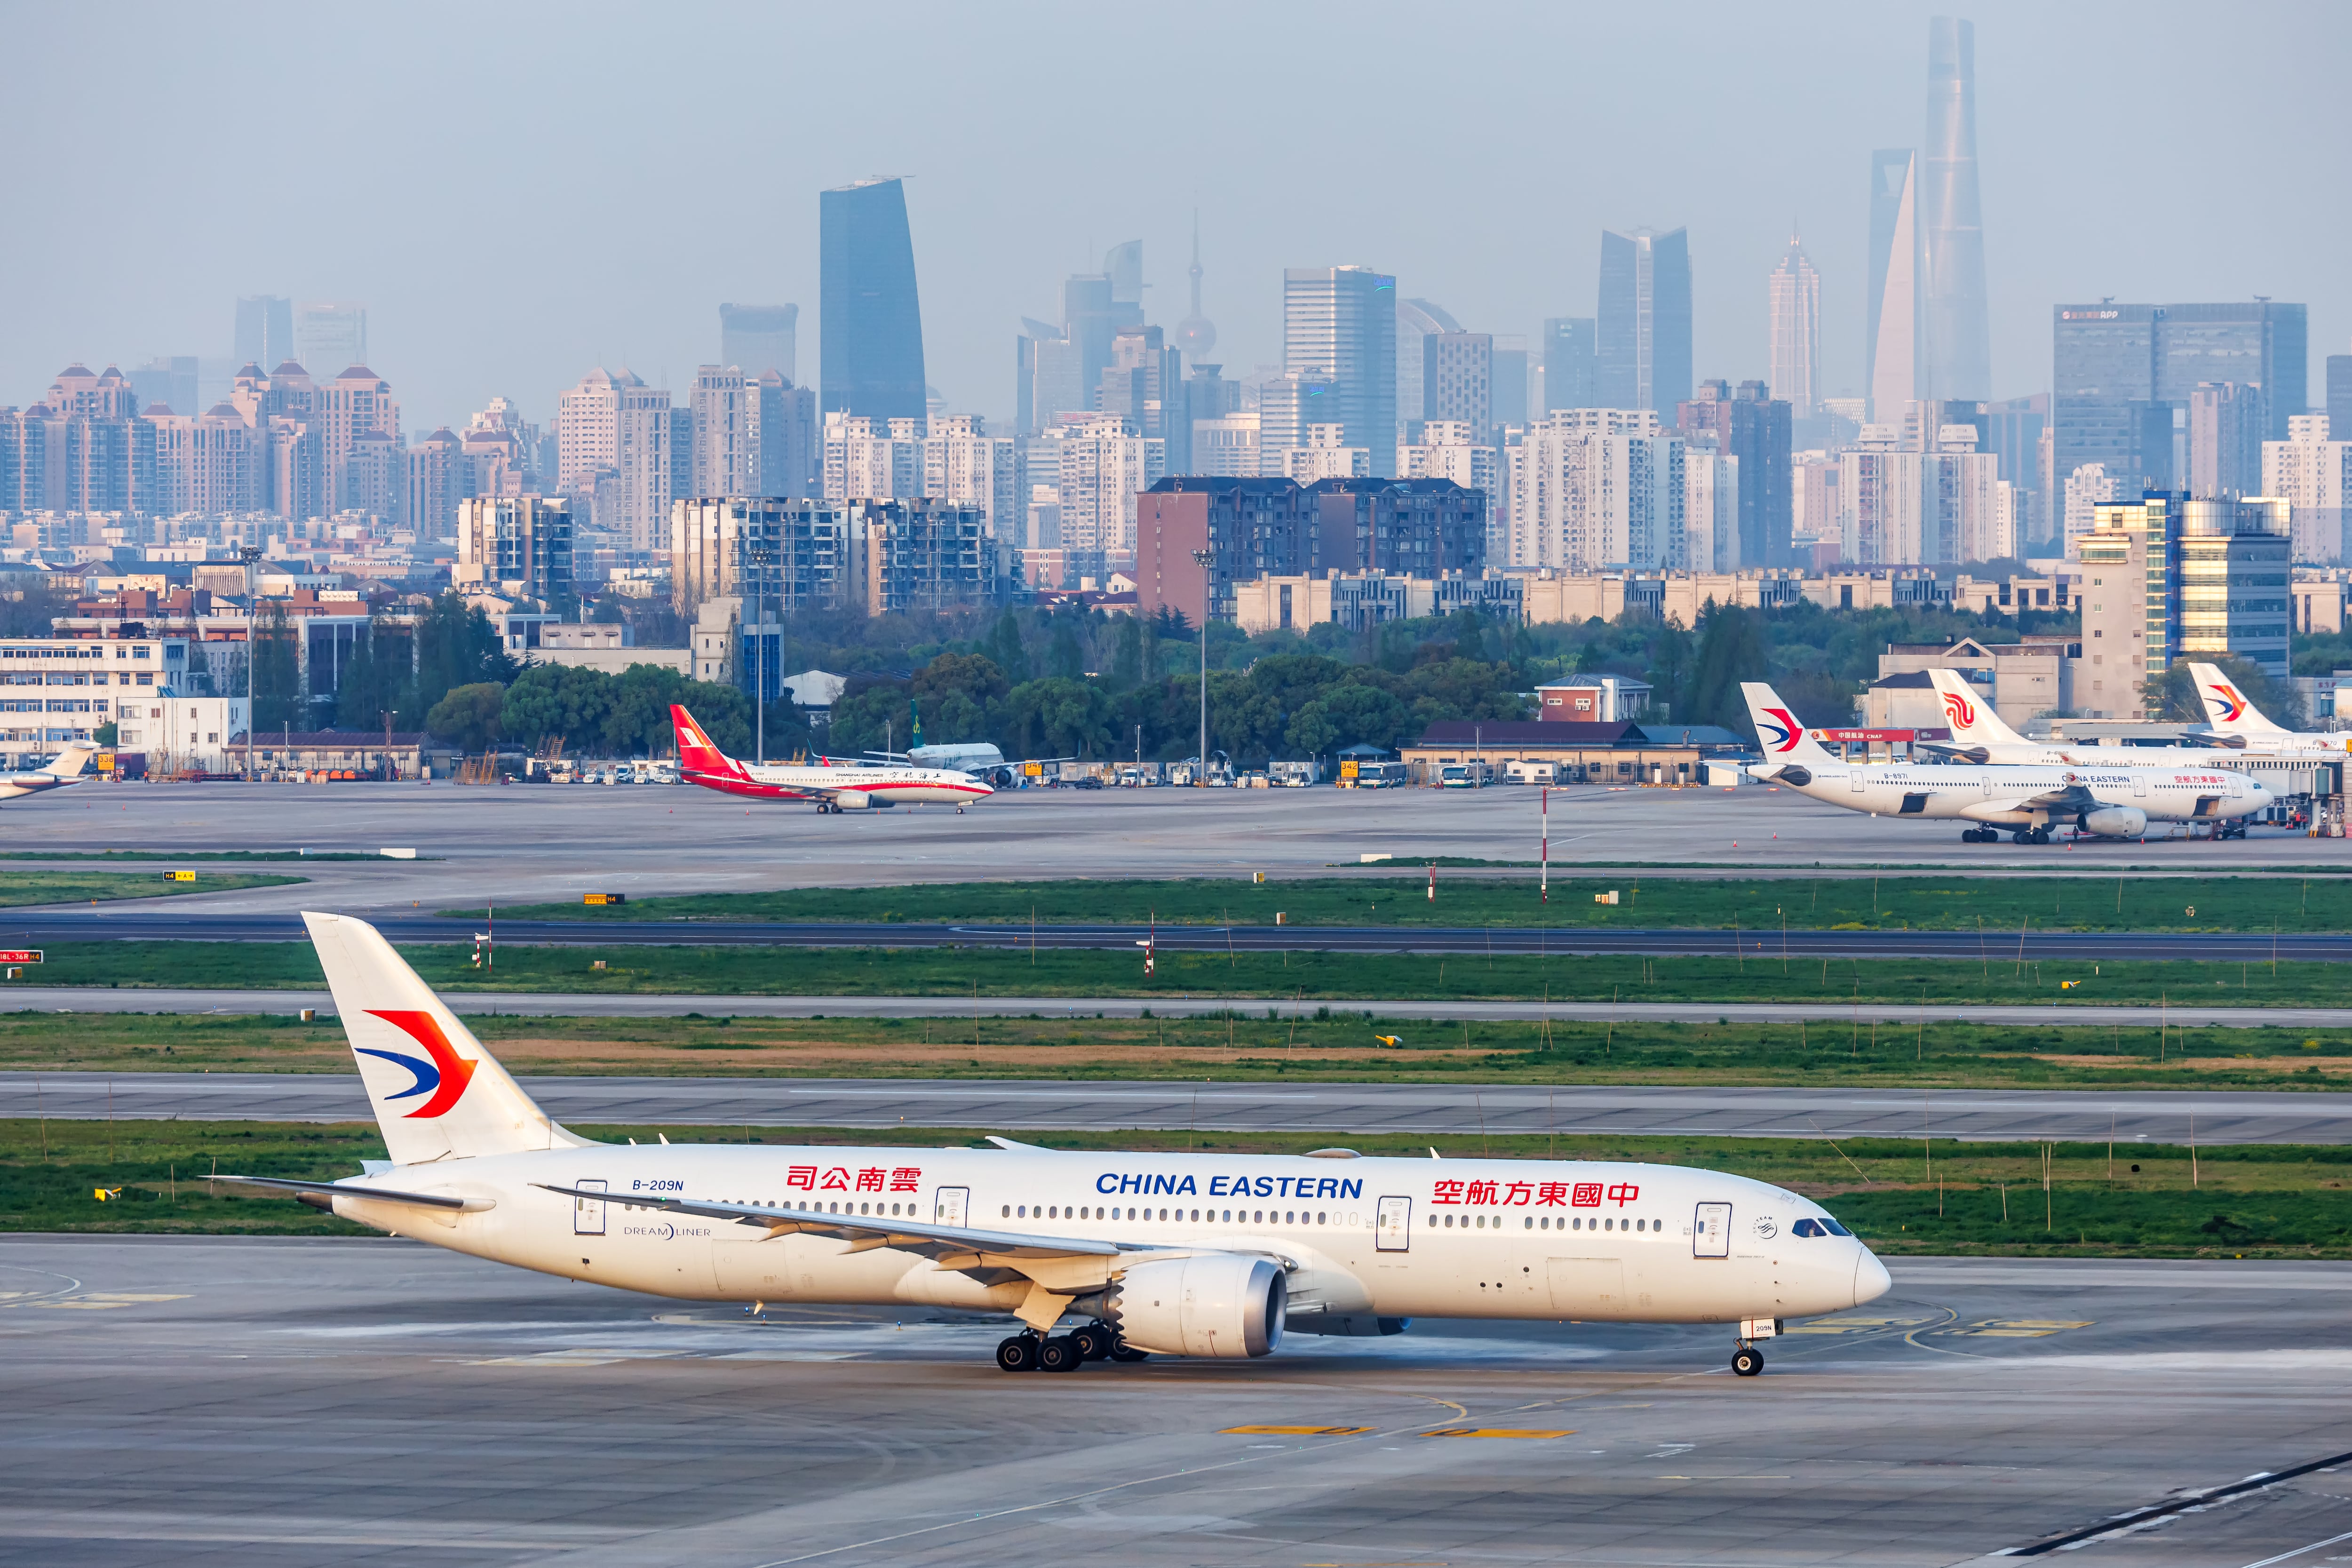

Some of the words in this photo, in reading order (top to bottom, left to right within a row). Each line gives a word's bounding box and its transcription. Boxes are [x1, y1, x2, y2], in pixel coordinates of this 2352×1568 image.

[633, 1180, 683, 1191] B-209N
[1096, 1173, 1197, 1195] CHINA
[1209, 1176, 1363, 1199] EASTERN
